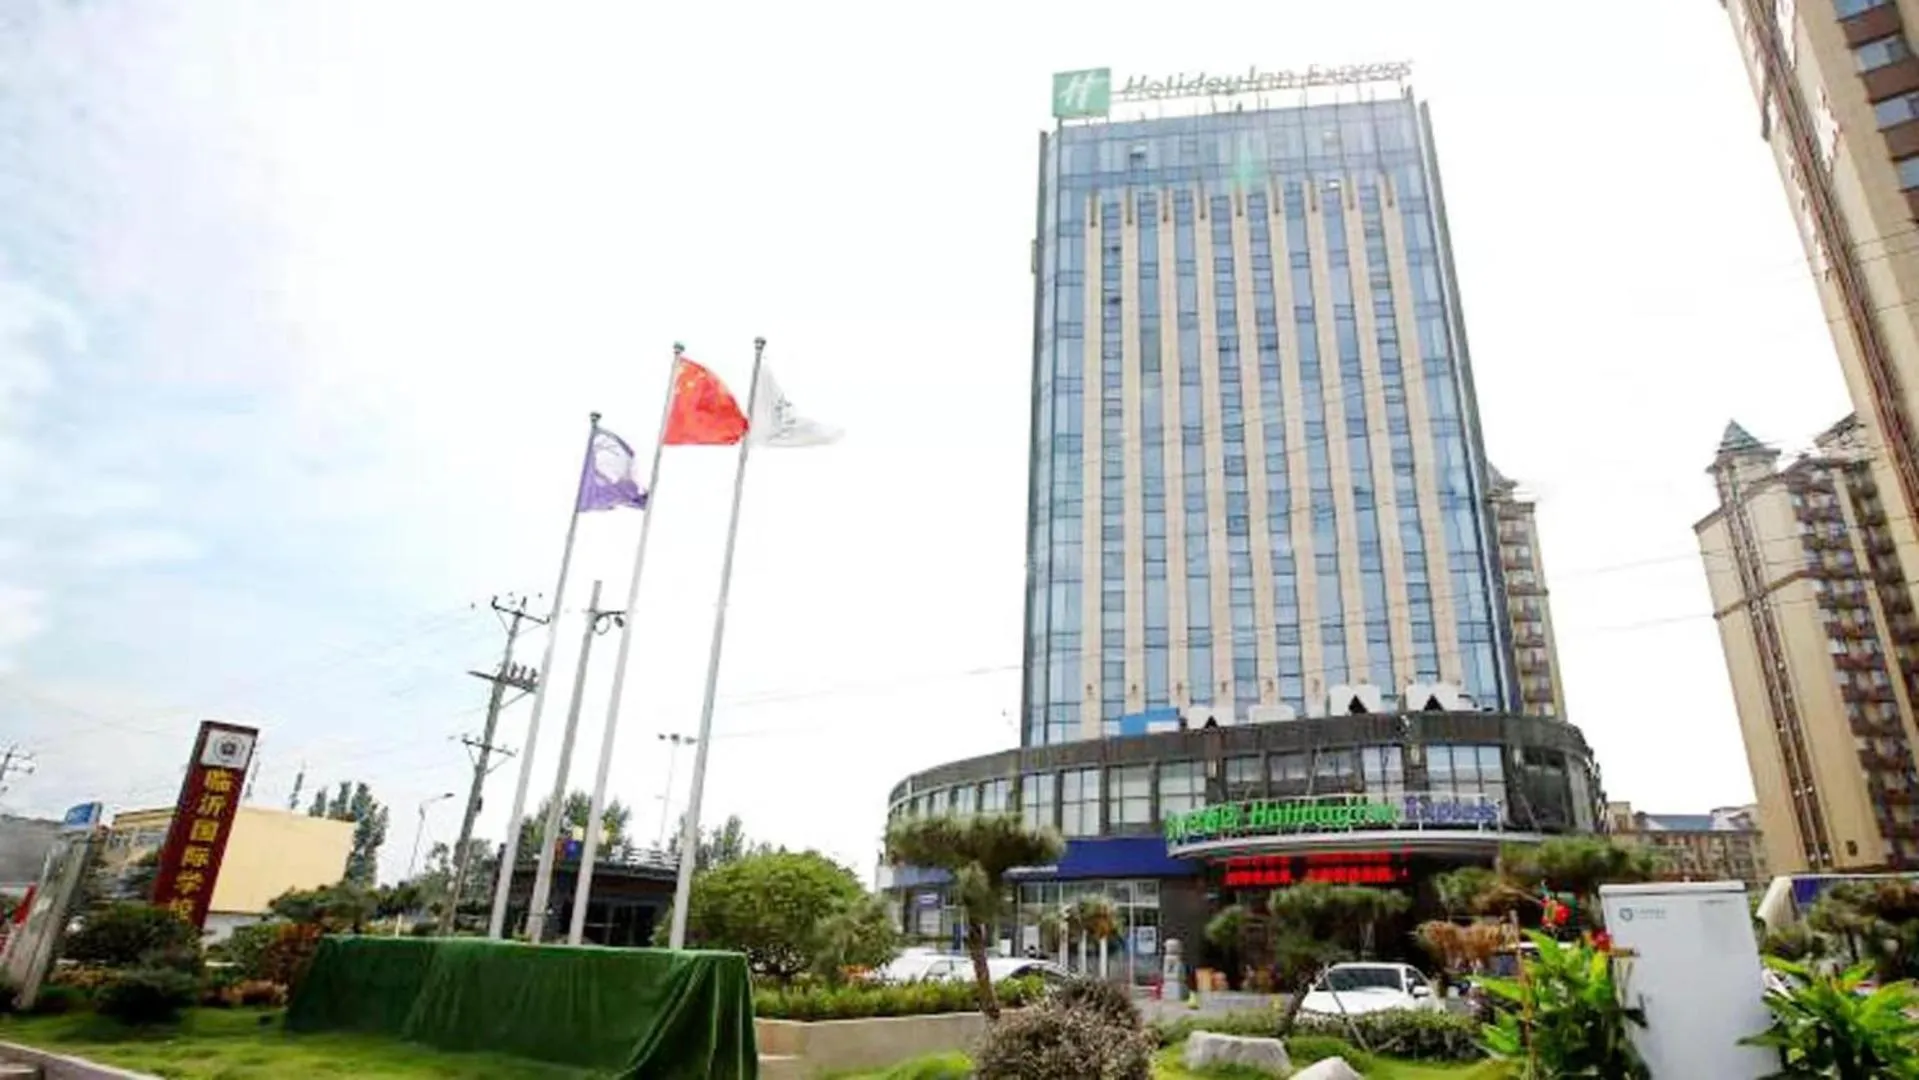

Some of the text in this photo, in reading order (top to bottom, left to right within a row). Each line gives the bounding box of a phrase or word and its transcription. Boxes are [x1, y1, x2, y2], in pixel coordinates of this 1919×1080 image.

[1122, 62, 1412, 99] Holiday Inn Express
[170, 768, 233, 921] 临沂国际学校
